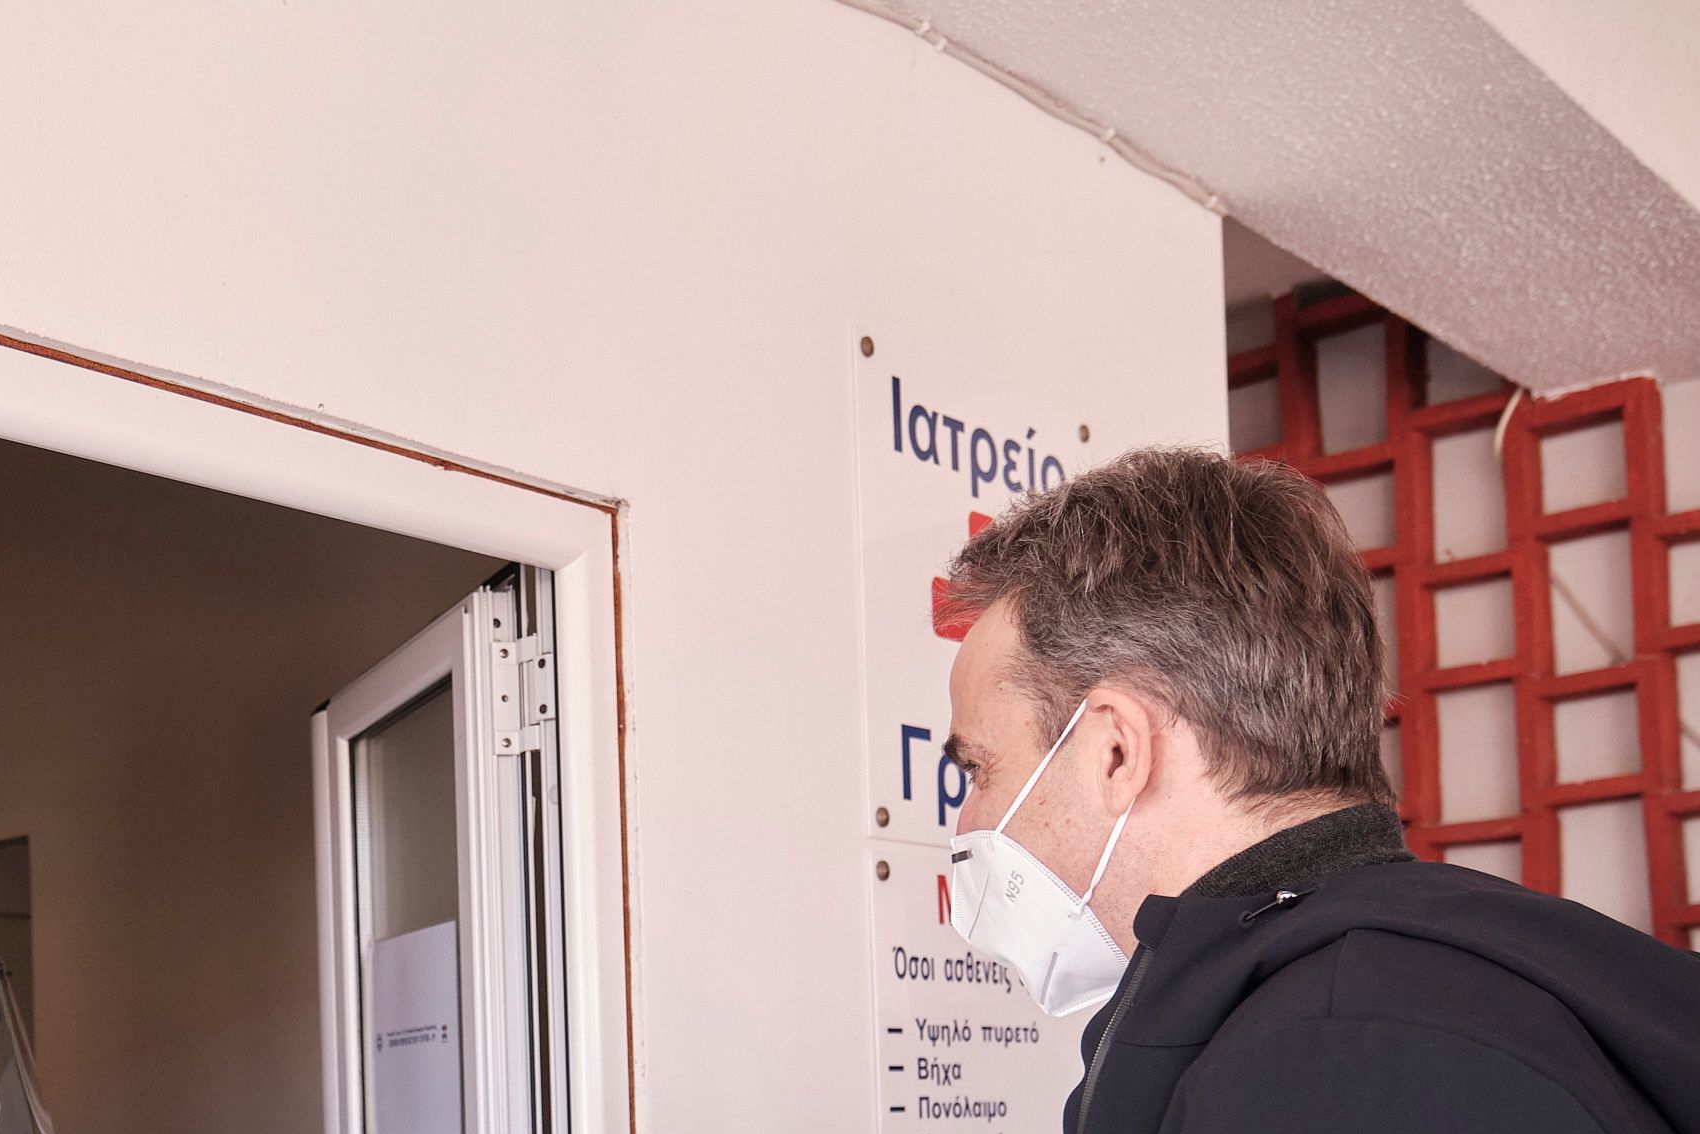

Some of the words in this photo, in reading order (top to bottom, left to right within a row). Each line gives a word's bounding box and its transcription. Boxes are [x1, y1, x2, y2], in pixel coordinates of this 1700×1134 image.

[1004, 869, 1025, 903] N95
[892, 946, 936, 981] Όσοι
[915, 1018, 972, 1048] Υψηλό
[980, 1021, 1040, 1049] πυρετό
[917, 1057, 962, 1087] Βήχα
[918, 1095, 1008, 1124] Πονόλαιμο
